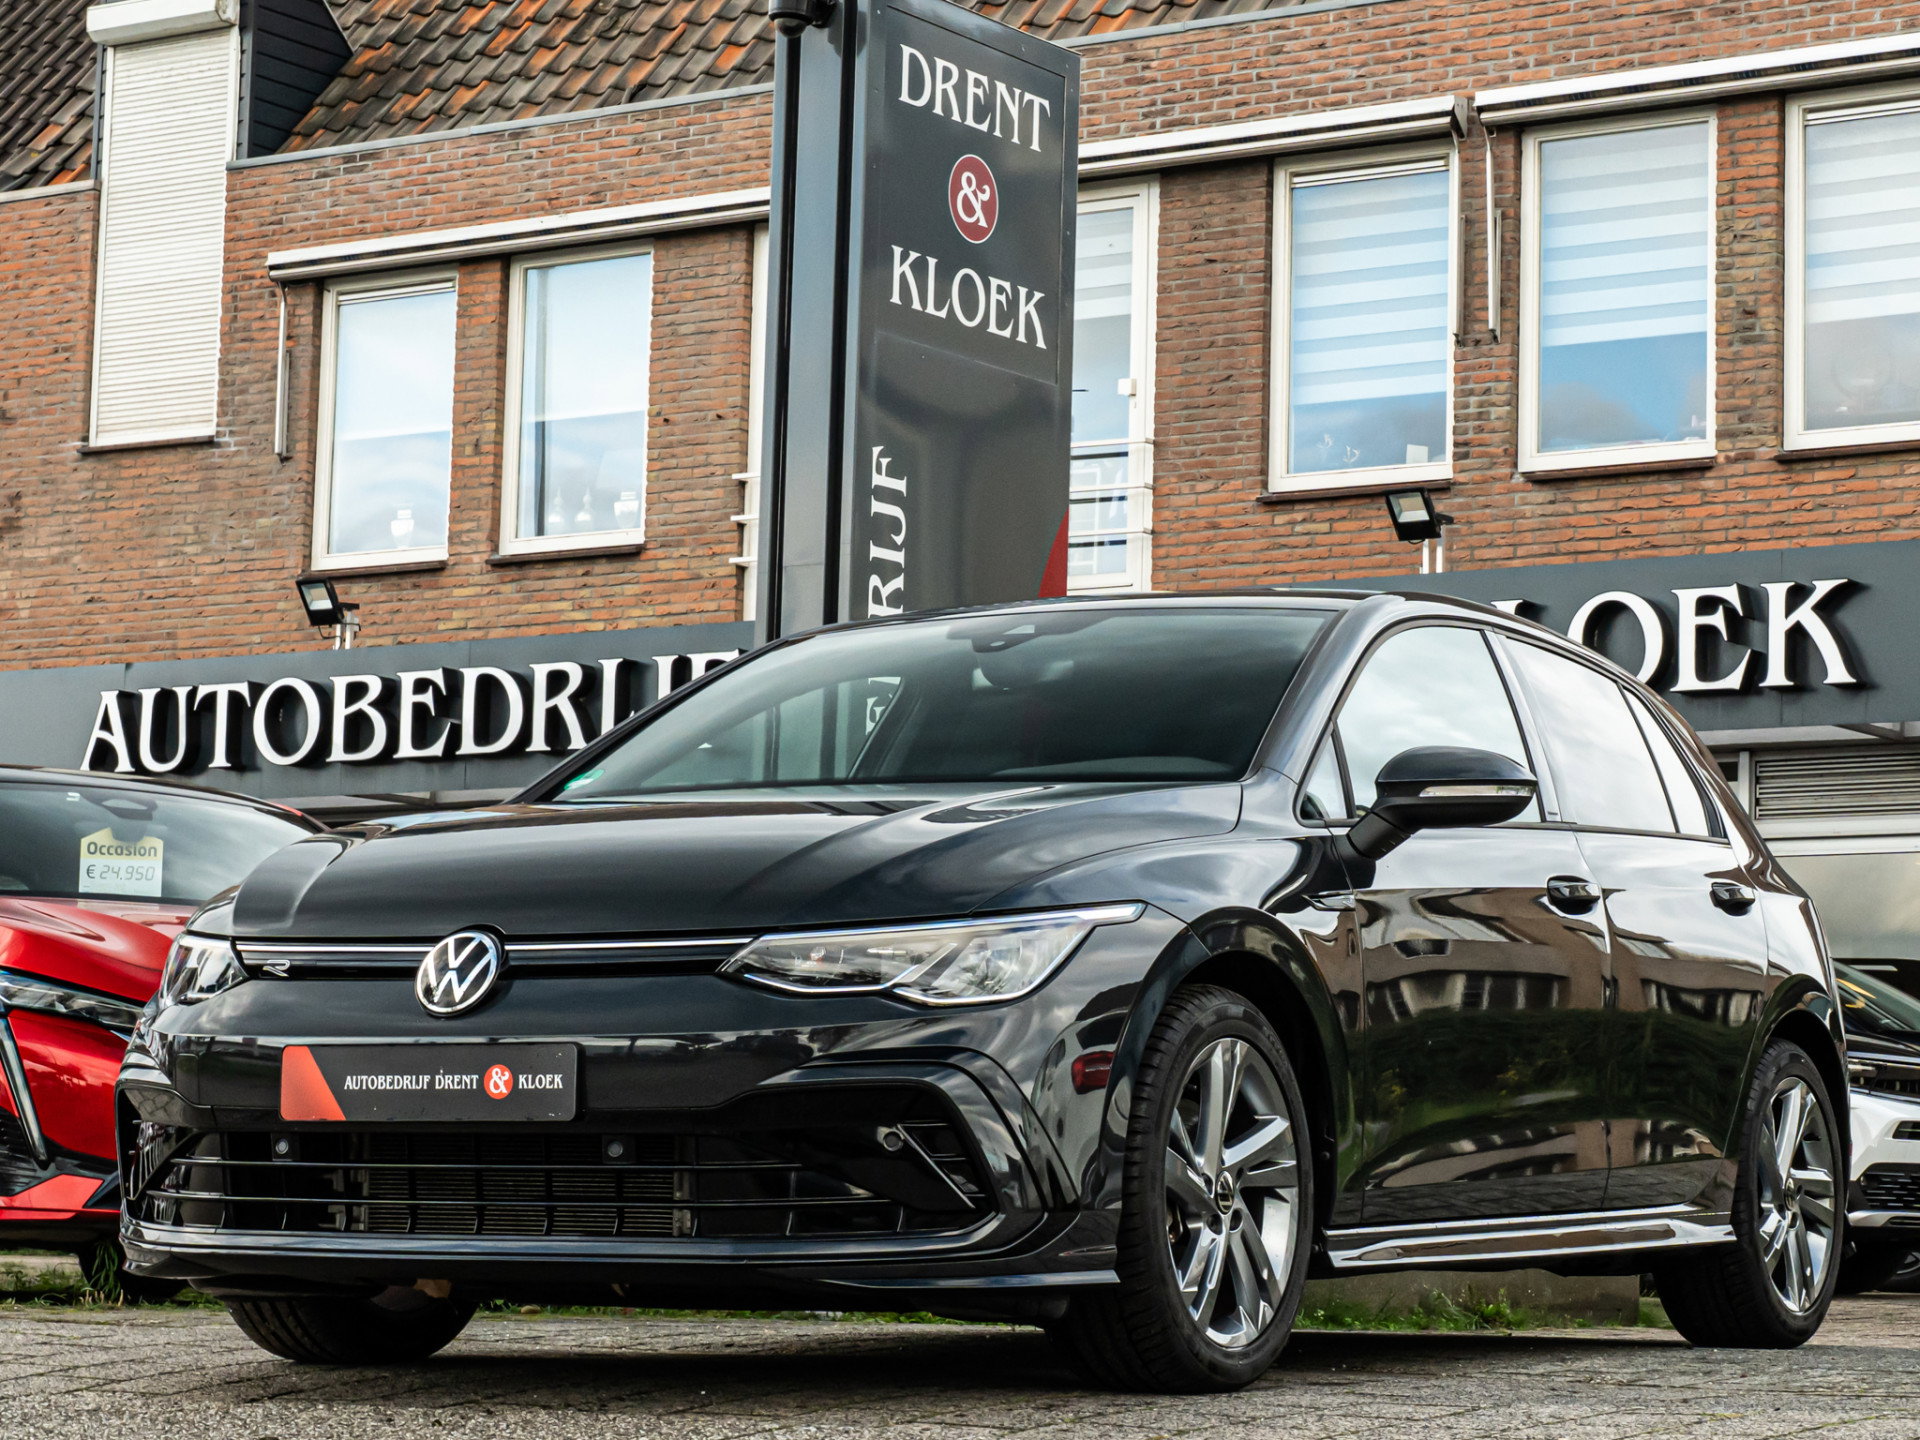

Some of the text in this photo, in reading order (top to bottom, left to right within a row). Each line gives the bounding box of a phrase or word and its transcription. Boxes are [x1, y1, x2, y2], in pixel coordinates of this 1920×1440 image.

[898, 44, 1051, 152] DRENT
[956, 171, 991, 228] &
[889, 244, 1047, 350] KLOEK
[1490, 578, 1858, 692] OEK
[86, 864, 156, 882] € 24.950
[87, 841, 158, 857] Occasion
[344, 1067, 563, 1094] AUTOBEDRIJF DRENT & KLOEK
